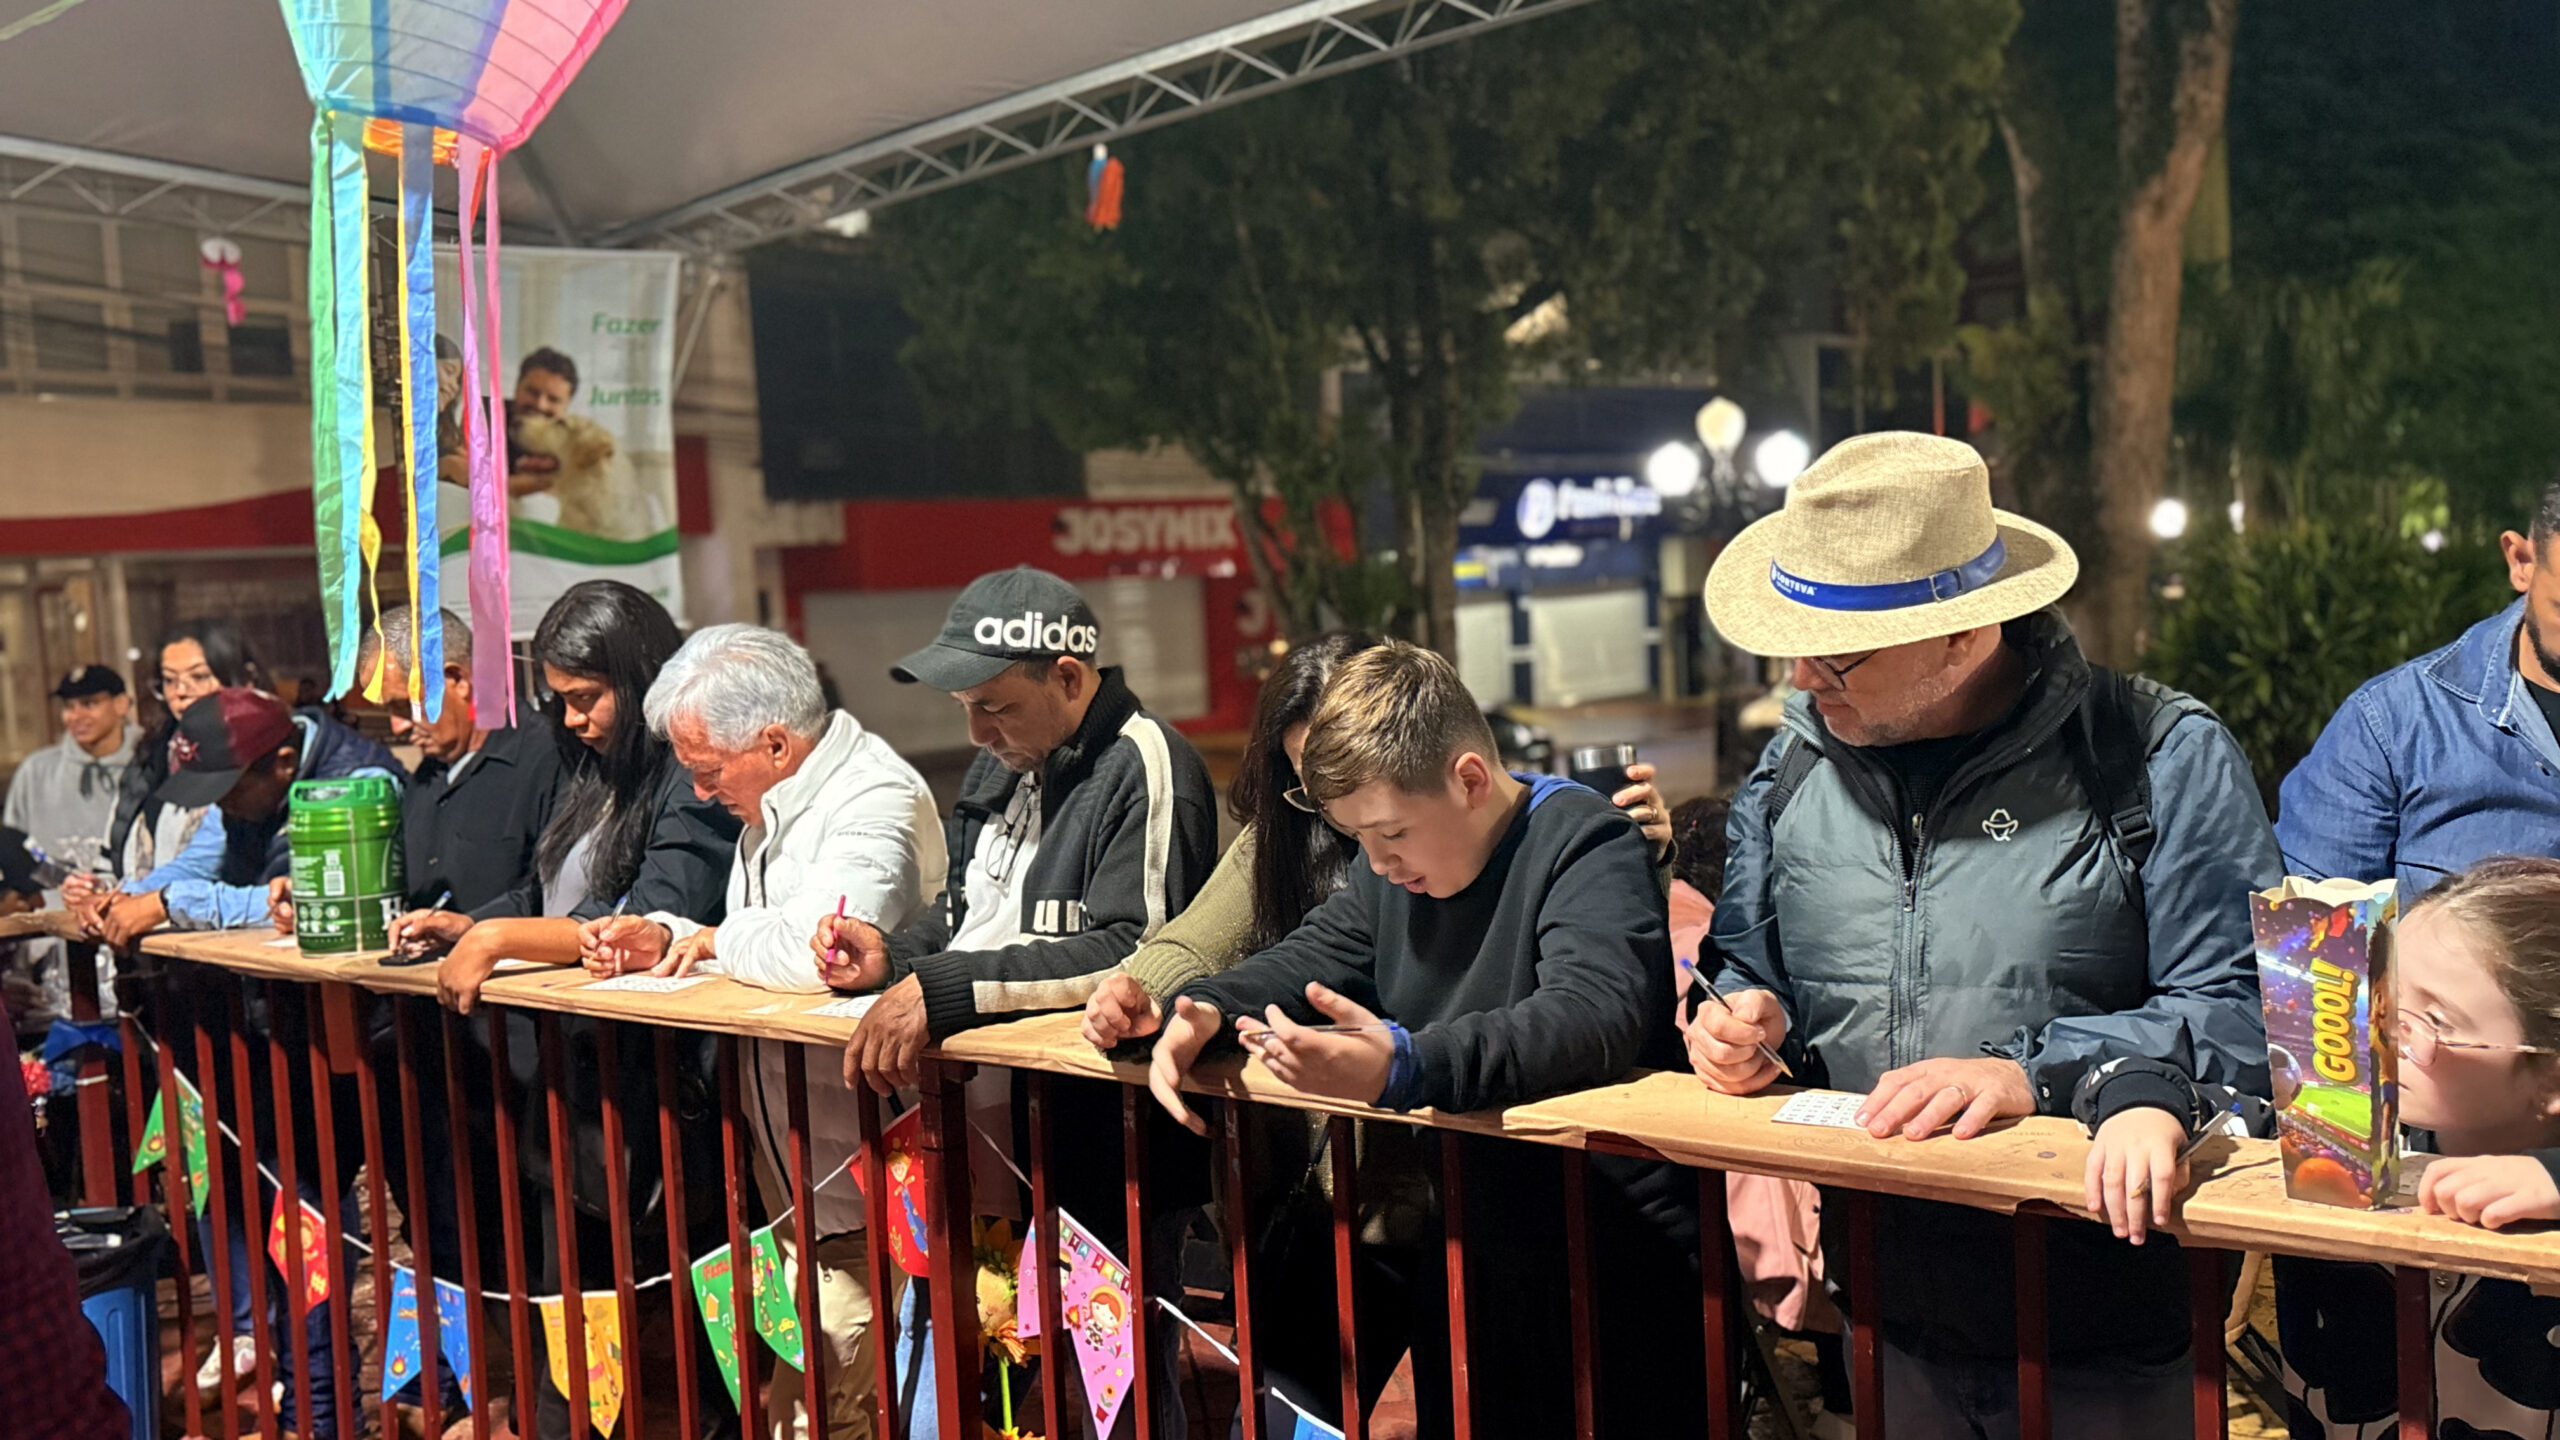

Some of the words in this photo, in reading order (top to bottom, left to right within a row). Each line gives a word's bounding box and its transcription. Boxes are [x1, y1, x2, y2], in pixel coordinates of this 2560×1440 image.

[592, 313, 661, 334] Fazer
[1054, 508, 1239, 554] JOSYMIX
[1776, 571, 1815, 596] CORTEVA
[974, 611, 1097, 653] adidas
[2311, 956, 2358, 1083] GOOOL!
